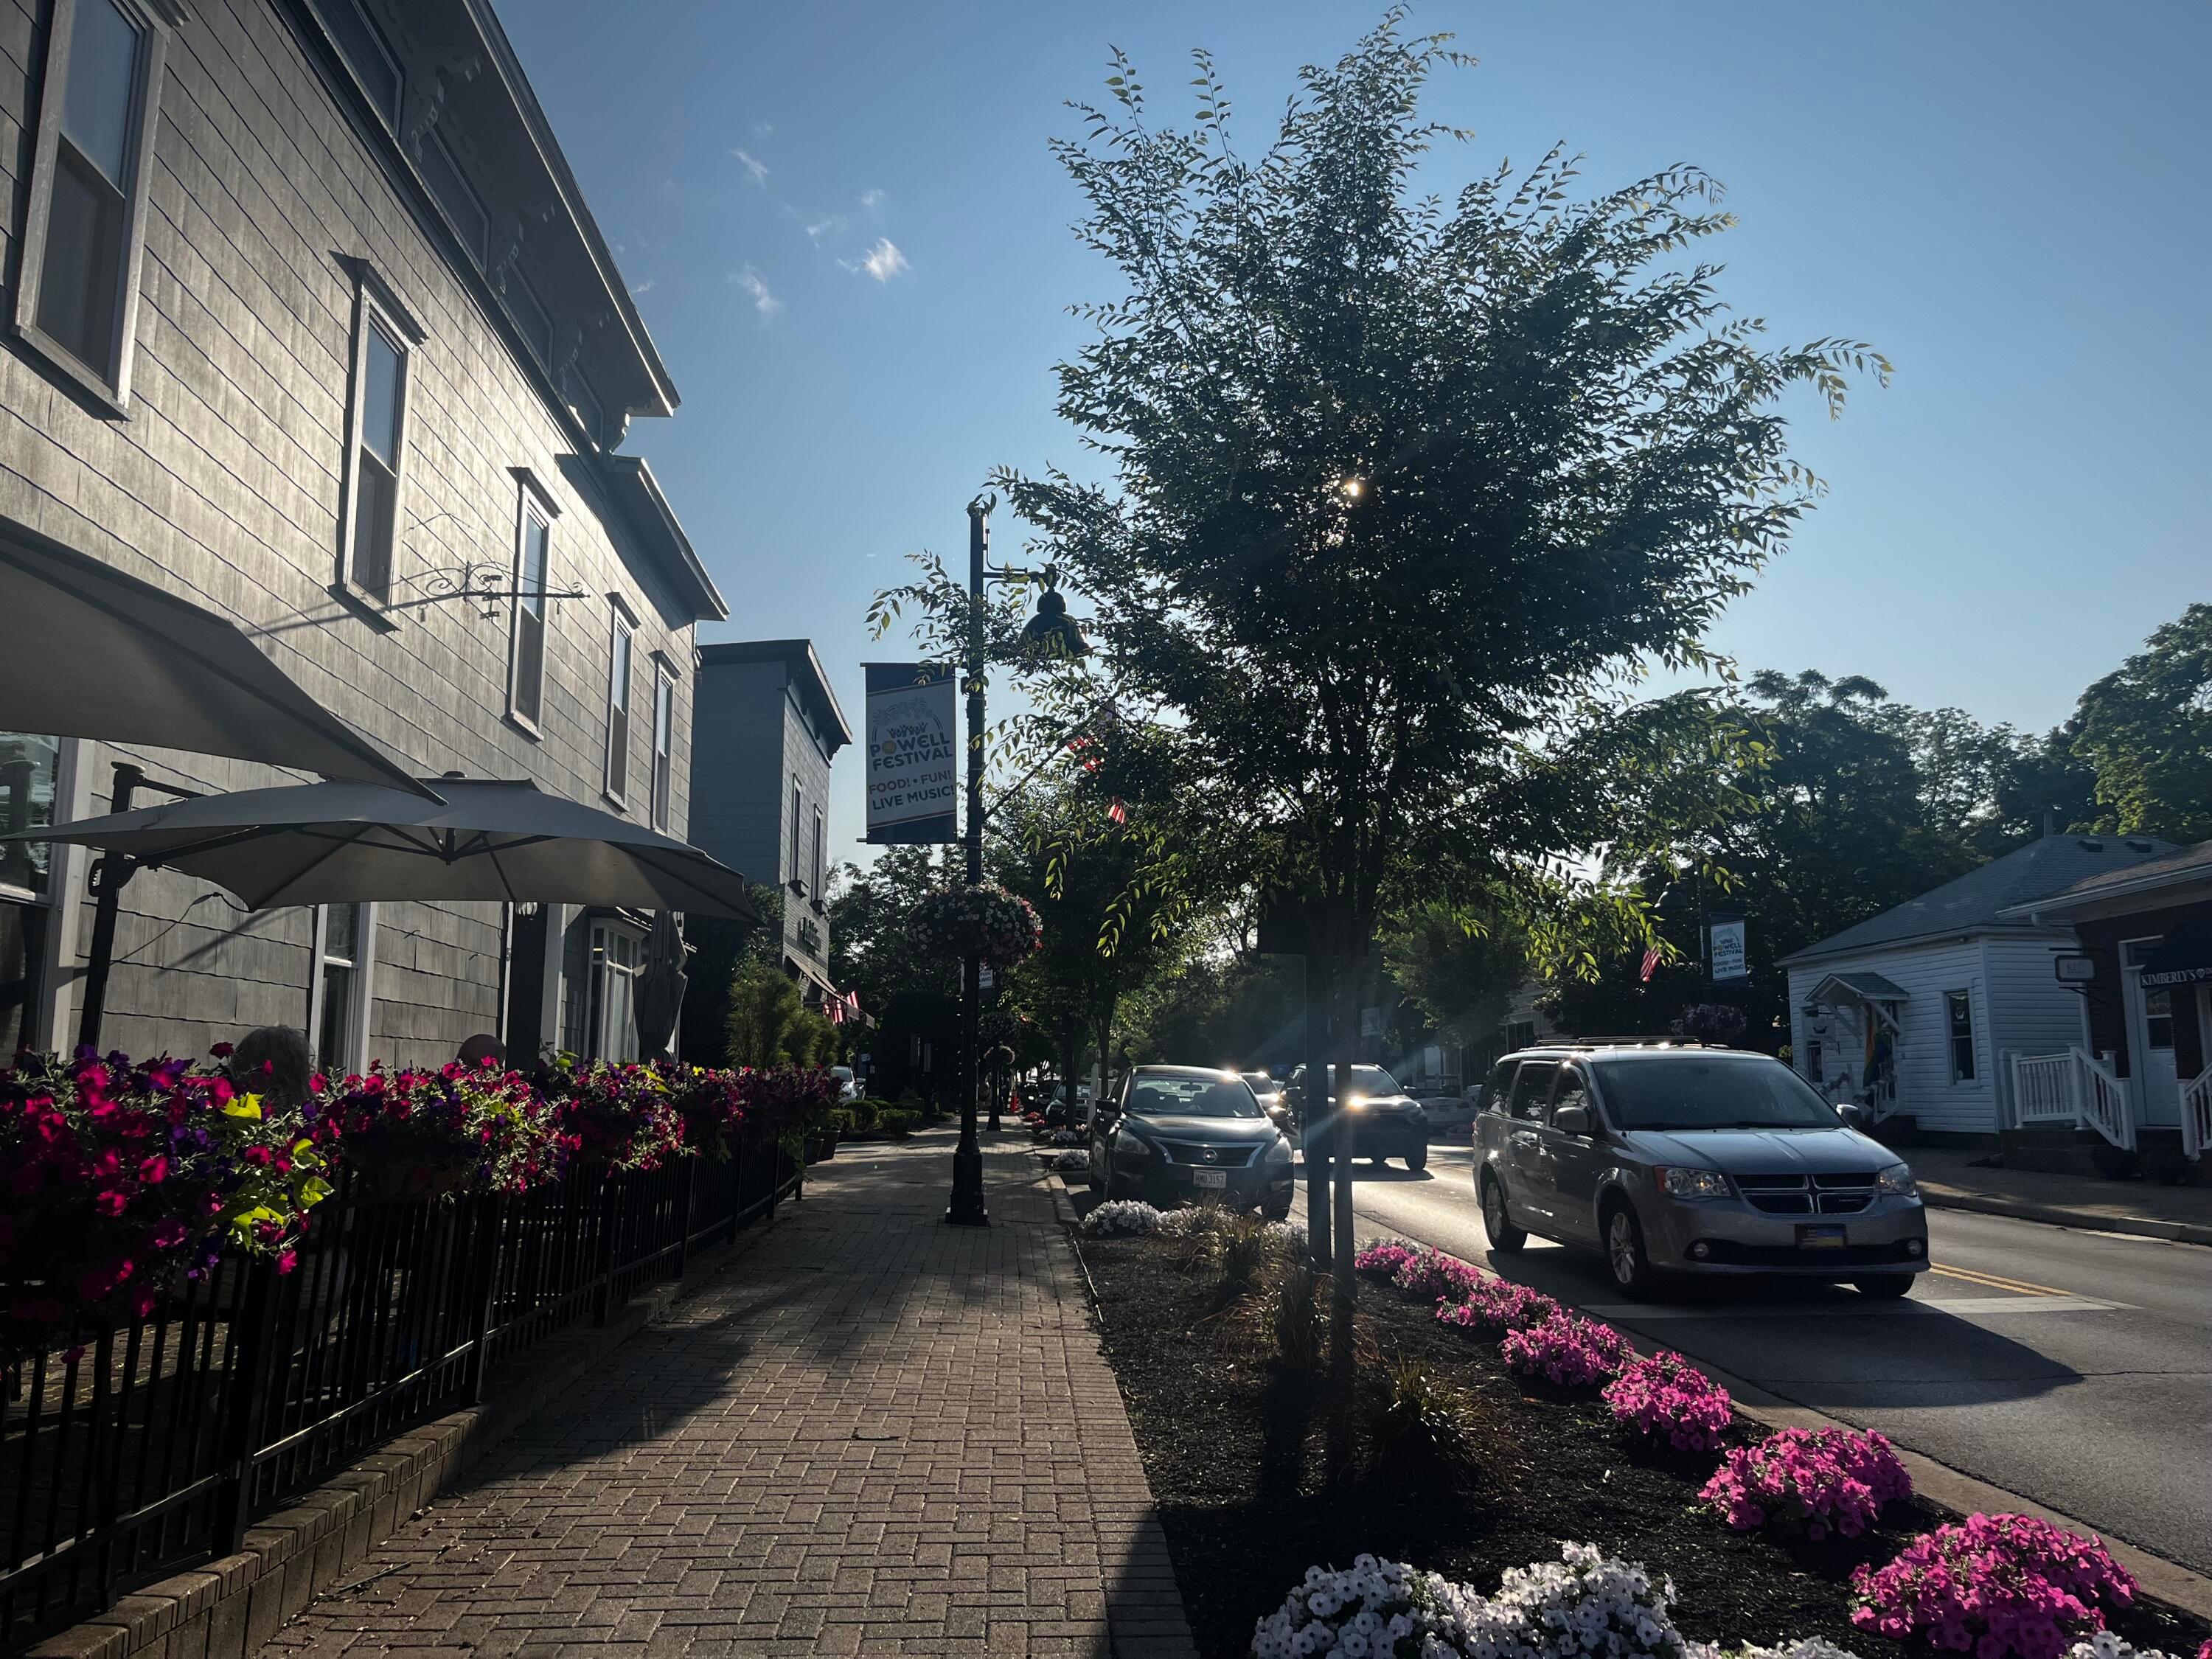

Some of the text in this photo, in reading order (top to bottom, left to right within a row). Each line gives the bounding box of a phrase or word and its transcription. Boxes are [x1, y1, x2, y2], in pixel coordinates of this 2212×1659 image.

[870, 732, 950, 757] POWELL
[872, 746, 953, 771] FESTIVAL
[869, 770, 952, 794] FOOD! FUN!
[872, 785, 955, 810] LIVE MUSIC!
[1713, 943, 1742, 951] POWELL
[1714, 948, 1743, 957] FESTIVAL
[2141, 969, 2196, 985] KIMBERLY'S
[1209, 1175, 1224, 1184] 3157
